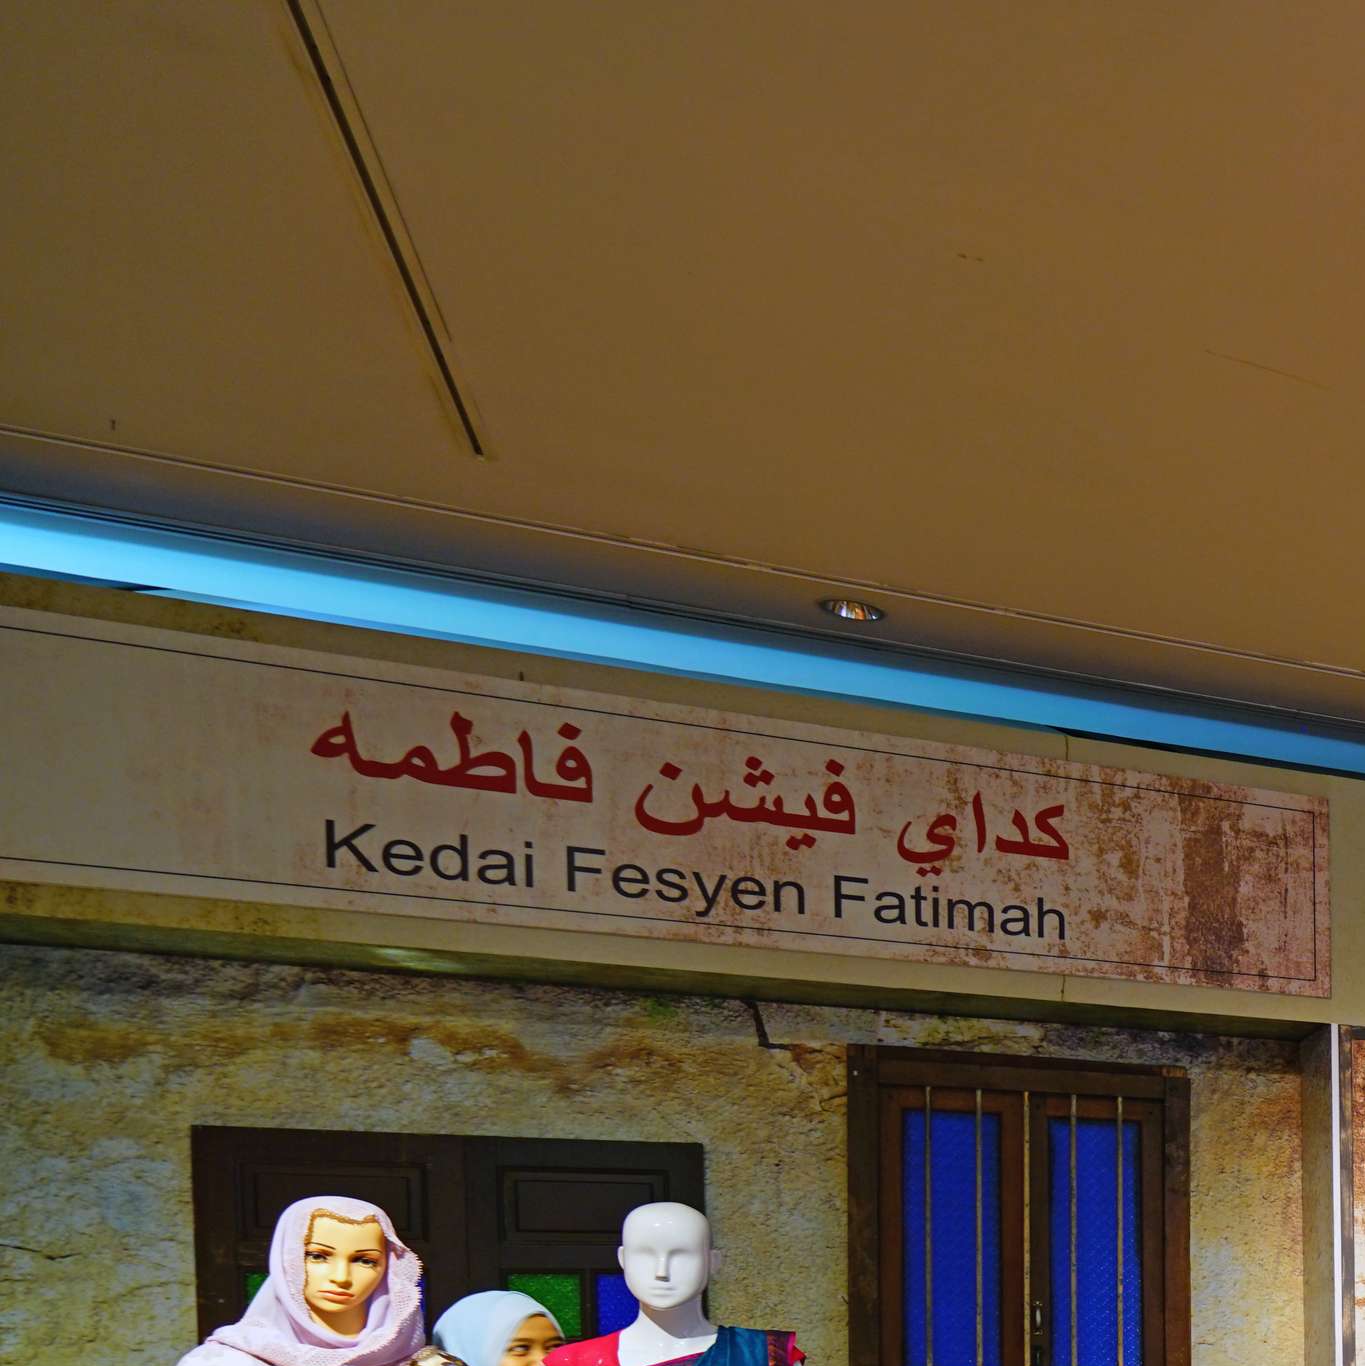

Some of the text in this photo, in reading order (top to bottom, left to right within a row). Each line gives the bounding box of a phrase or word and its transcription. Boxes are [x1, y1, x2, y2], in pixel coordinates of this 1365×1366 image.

[634, 755, 856, 850] فيشن
[897, 790, 1069, 877] كداي
[325, 818, 1067, 940] Kedai Fesyen Fatimah
